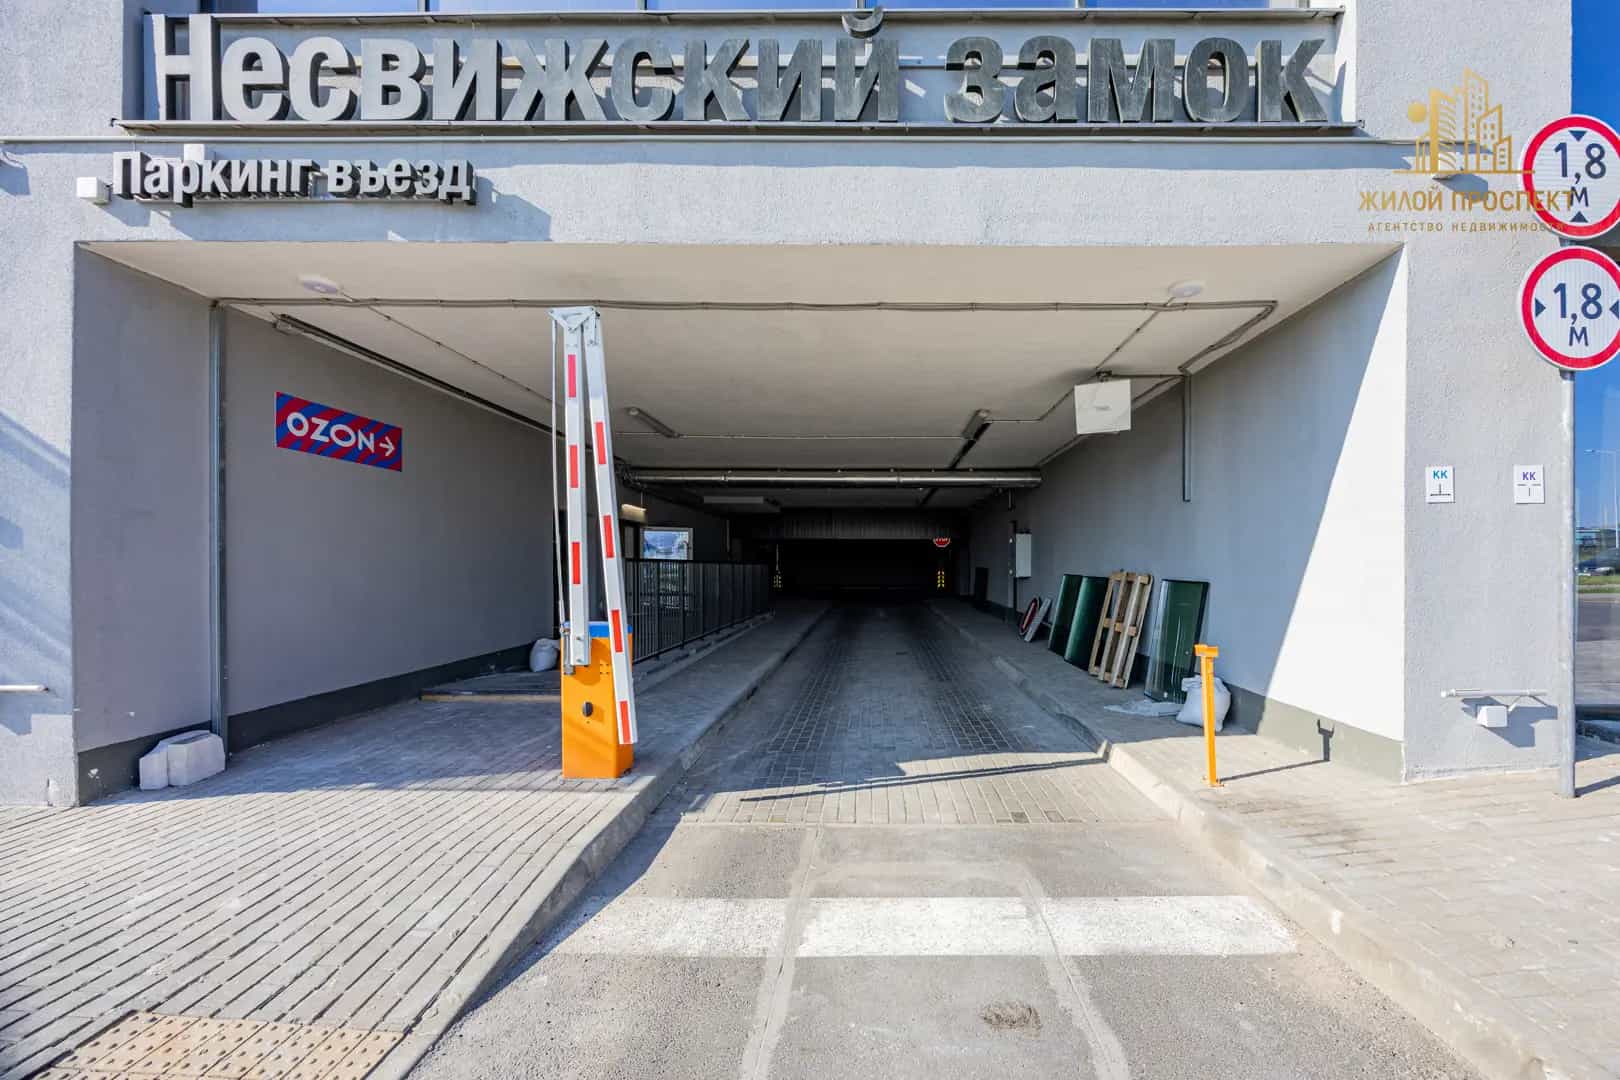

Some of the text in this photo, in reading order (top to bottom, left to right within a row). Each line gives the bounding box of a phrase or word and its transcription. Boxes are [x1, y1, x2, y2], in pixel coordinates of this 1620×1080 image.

[152, 8, 1328, 123] Несвижский замок
[112, 151, 476, 204] Паркинг въезд
[1554, 142, 1607, 184] 1,8
[1553, 282, 1603, 324] 1,8
[286, 411, 375, 453] OZON
